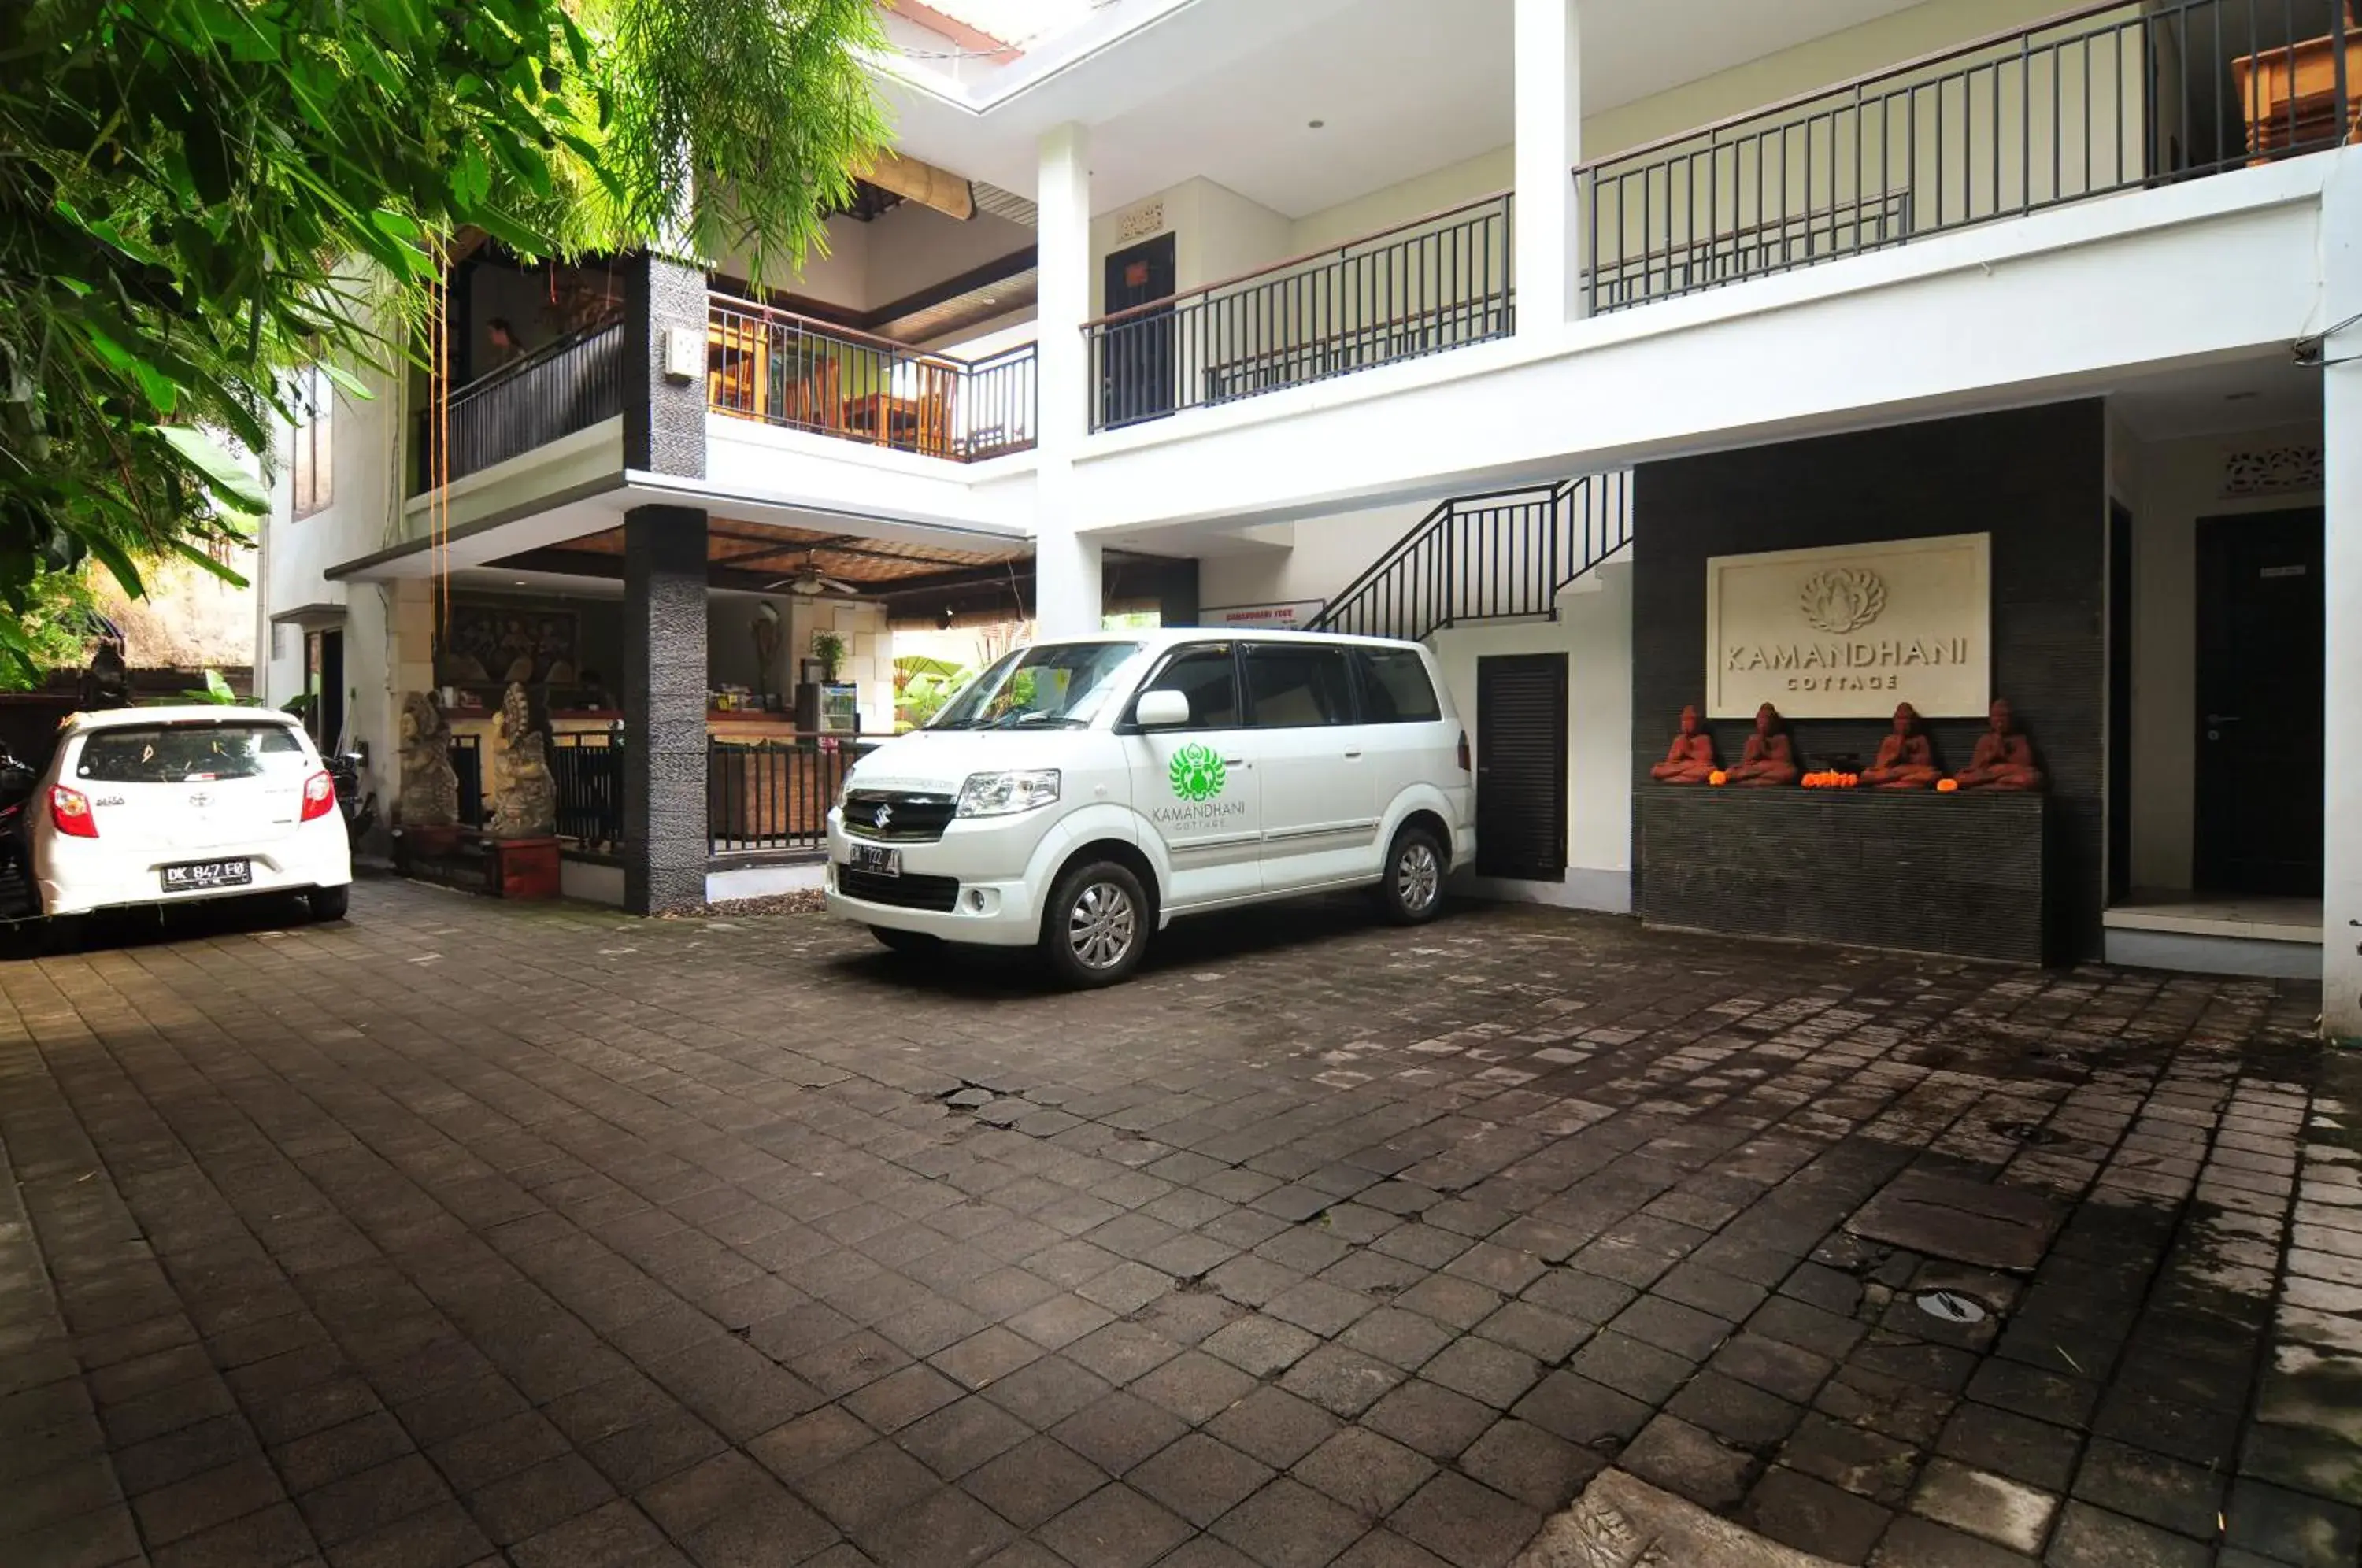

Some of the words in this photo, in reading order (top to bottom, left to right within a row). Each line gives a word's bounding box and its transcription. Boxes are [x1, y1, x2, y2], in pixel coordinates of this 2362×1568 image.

[1728, 637, 1968, 671] KAMANDHANI
[1787, 675, 1898, 691] COTTAGE
[1152, 801, 1246, 822] KAMANDHANI
[1175, 819, 1227, 830] COTTAGE
[167, 867, 187, 880] DK
[193, 864, 220, 878] 847
